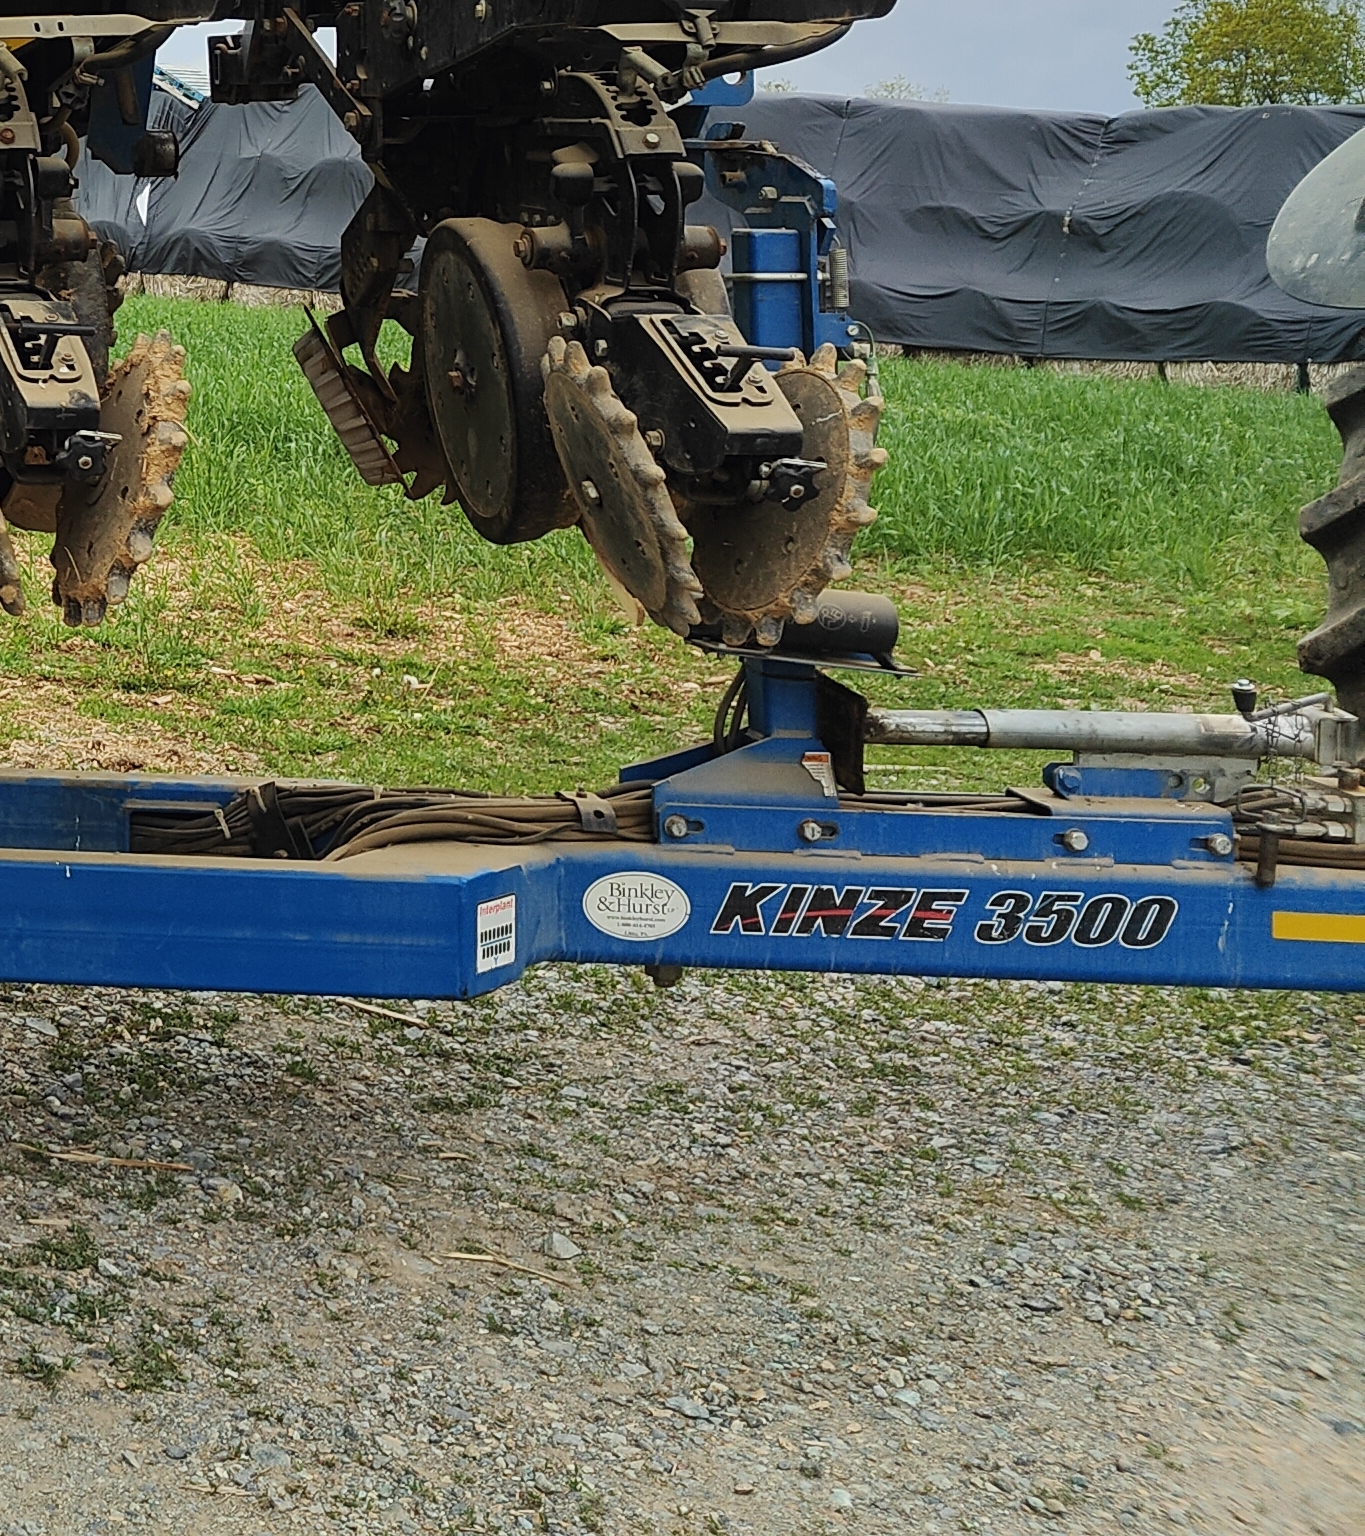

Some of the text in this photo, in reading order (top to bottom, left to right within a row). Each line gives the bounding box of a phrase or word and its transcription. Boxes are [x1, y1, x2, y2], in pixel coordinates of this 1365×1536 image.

[609, 882, 676, 905] Binkley
[597, 896, 667, 915] &Hurst
[709, 882, 1178, 949] KINZE 3500
